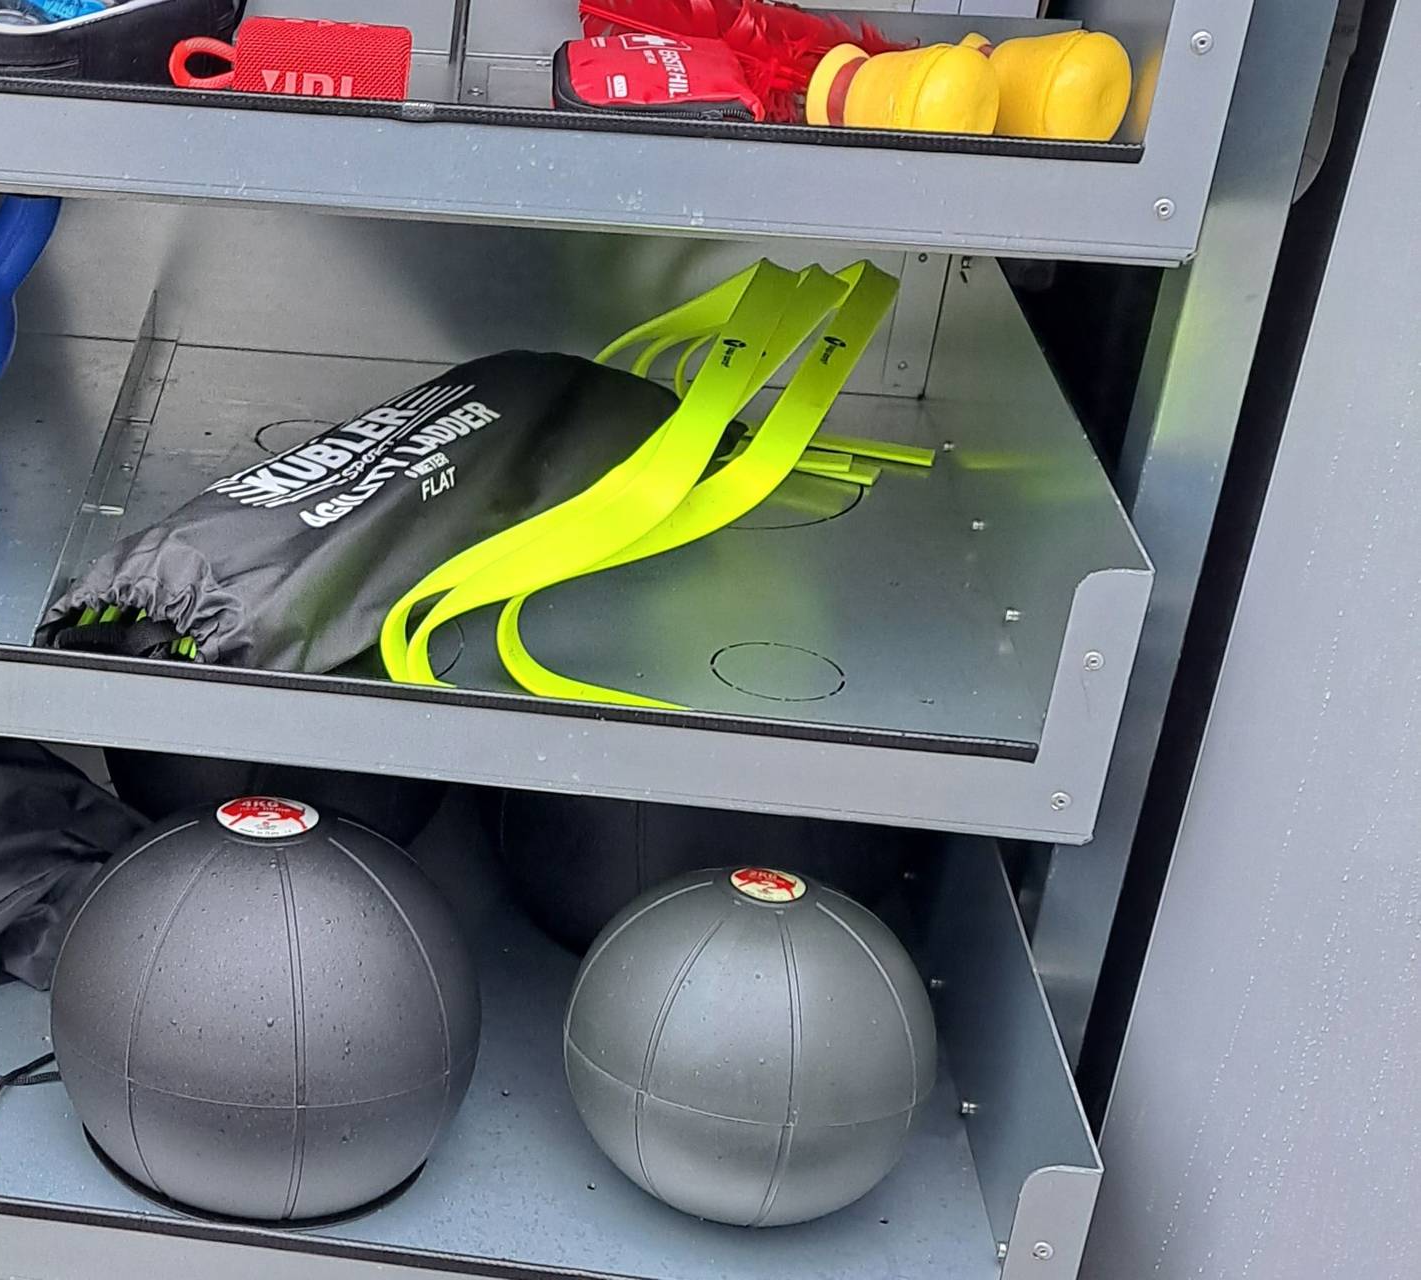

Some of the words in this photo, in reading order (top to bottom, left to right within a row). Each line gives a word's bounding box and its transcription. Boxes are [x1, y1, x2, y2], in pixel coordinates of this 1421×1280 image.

[667, 71, 692, 98] HIL
[393, 402, 501, 455] LADDER
[421, 466, 456, 501] FLAT
